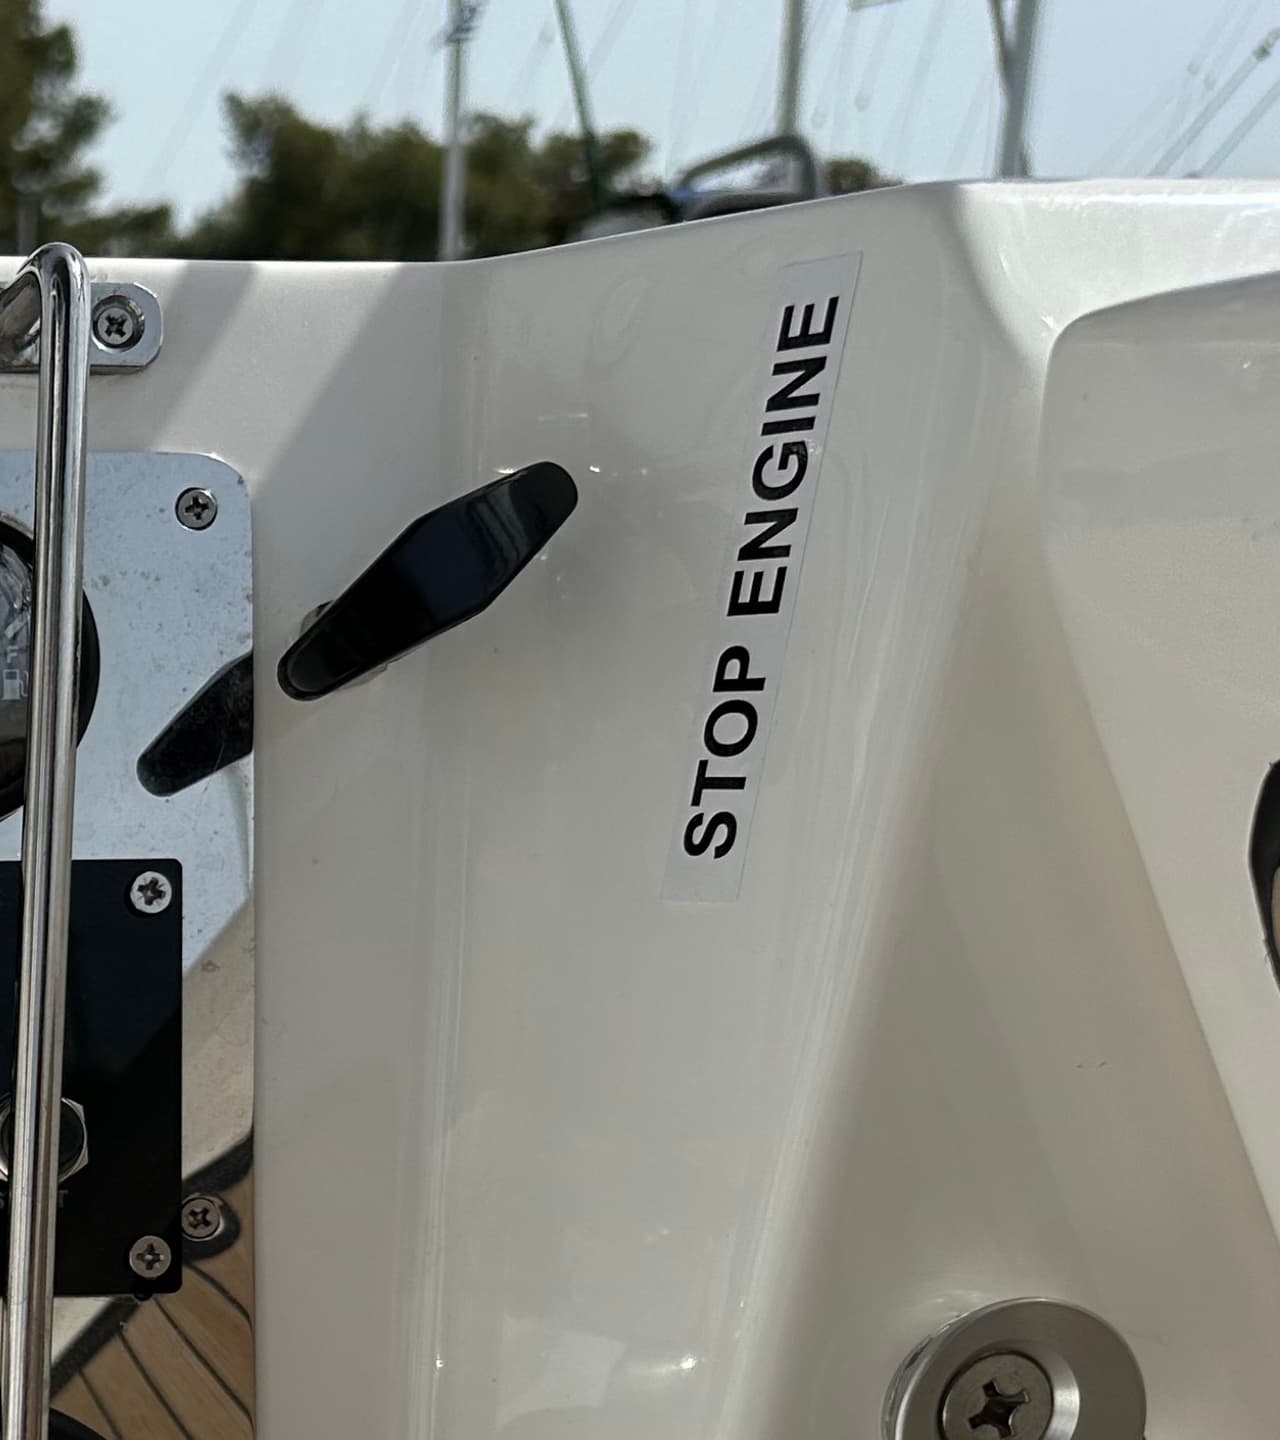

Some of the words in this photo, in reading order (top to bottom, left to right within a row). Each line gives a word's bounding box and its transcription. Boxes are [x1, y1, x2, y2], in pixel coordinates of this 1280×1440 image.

[6, 645, 20, 664] F
[683, 645, 767, 860] STOP
[726, 295, 840, 618] ENGINE
